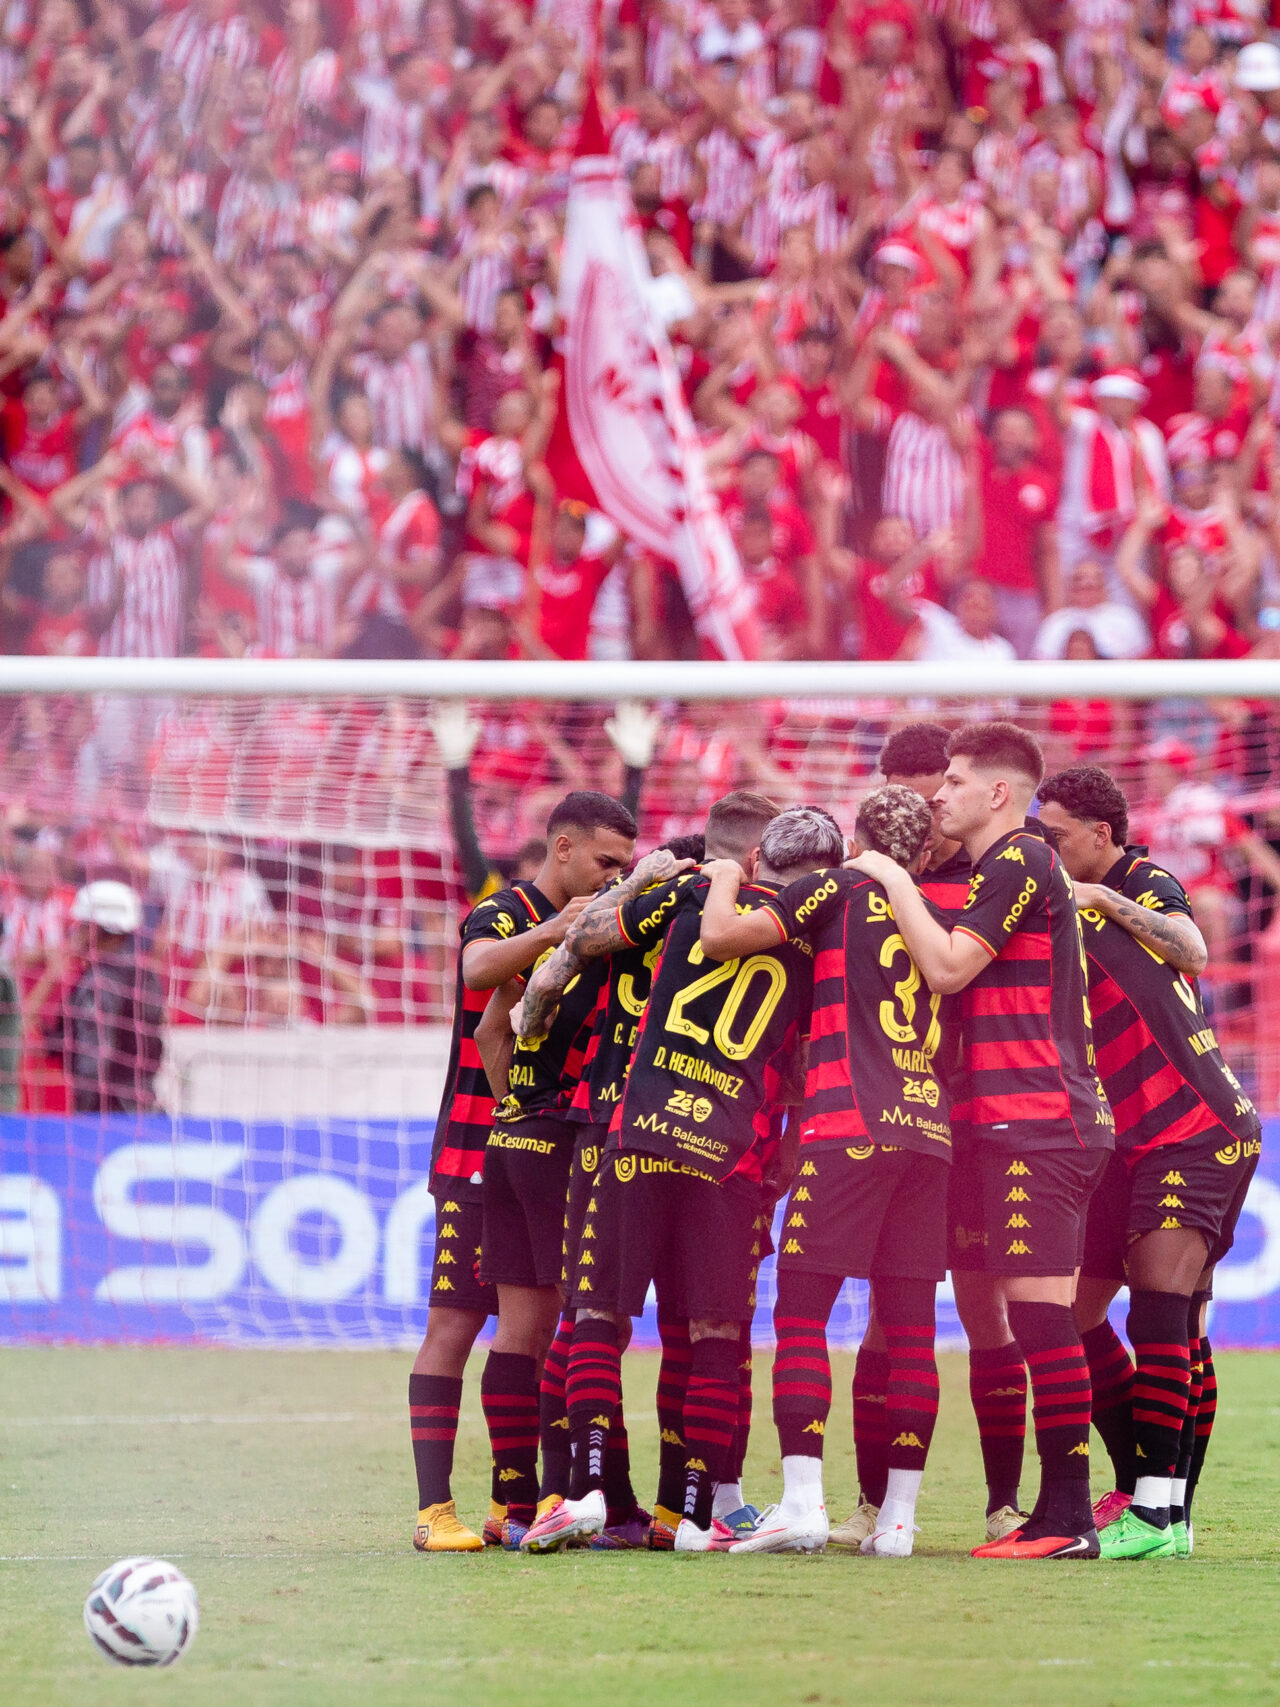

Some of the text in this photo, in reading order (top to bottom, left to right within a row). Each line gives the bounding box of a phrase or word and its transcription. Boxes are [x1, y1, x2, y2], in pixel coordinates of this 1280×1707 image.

[795, 878, 838, 924] mood
[1002, 876, 1037, 933] mood
[664, 939, 787, 1061] 20
[652, 1046, 666, 1069] D.
[671, 1126, 729, 1155] BaladAPP
